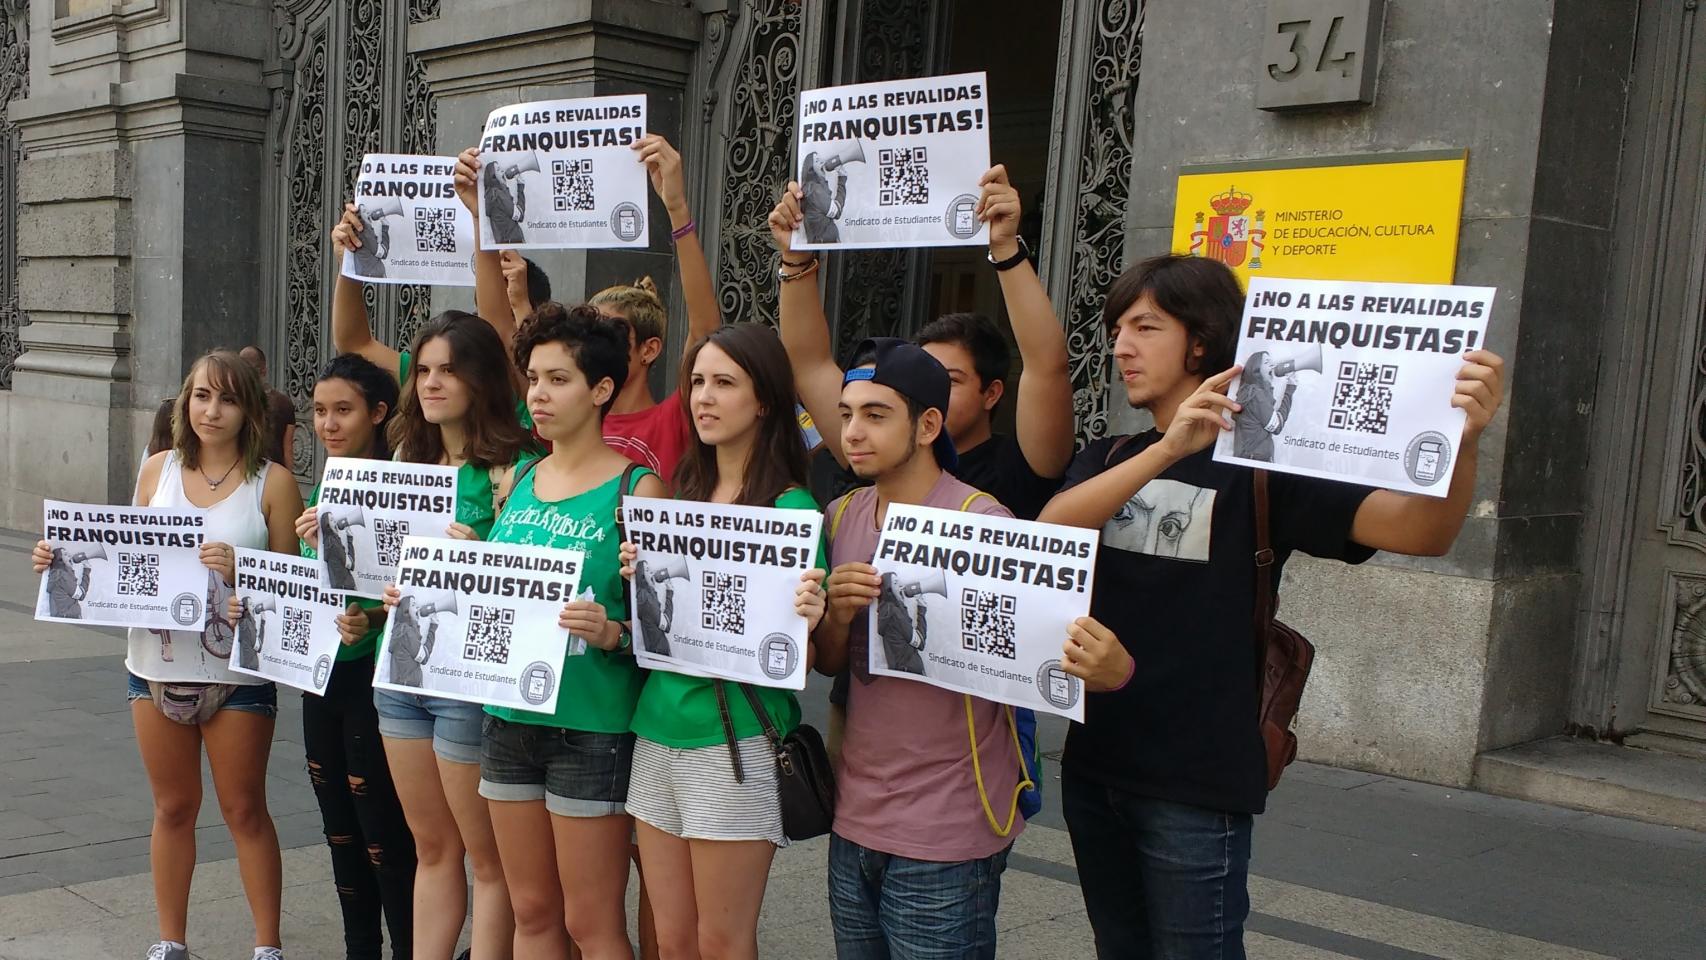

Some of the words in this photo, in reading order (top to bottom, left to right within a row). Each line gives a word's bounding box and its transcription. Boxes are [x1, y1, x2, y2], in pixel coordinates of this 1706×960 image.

[1268, 16, 1355, 82] 34
[804, 100, 827, 117] ¡NO
[832, 98, 842, 111] A
[848, 95, 878, 109] LAS
[884, 85, 981, 107] REVALIDAS
[488, 116, 506, 131] ¡NO
[510, 114, 519, 126] A
[525, 111, 550, 124] LAS
[556, 105, 641, 122] REVALIDAS
[803, 109, 983, 142] FRANQUISTAS!
[481, 127, 642, 152] FRANQUISTAS!
[376, 163, 385, 174] A
[391, 164, 418, 174] LAS
[357, 181, 455, 199] FRANQUIS
[569, 220, 607, 228] Estudiantes
[845, 217, 880, 226] Sindicato
[882, 217, 892, 225] de
[895, 215, 941, 224] Estudiantes
[1276, 210, 1343, 222] MINISTERIO
[1274, 228, 1290, 238] DE
[1292, 225, 1371, 238] EDUCACIÓN,
[1375, 224, 1434, 236] CULTURA
[1272, 246, 1280, 255] Y
[1282, 244, 1336, 255] DEPORTE
[1253, 291, 1291, 308] ¡NO
[1297, 293, 1311, 309] A
[1318, 294, 1354, 311] LAS
[1362, 296, 1484, 318] REVALIDAS
[1247, 316, 1478, 354] FRANQUISTAS!
[1284, 435, 1325, 450] Sindicato
[1328, 442, 1340, 452] de
[1343, 444, 1400, 460] Estudiantes
[326, 469, 343, 481] ¡NO
[346, 470, 352, 480] A
[357, 470, 377, 482] LAS
[382, 472, 452, 488] REVALIDAS
[321, 488, 452, 514] FRANQUISTAS!
[48, 510, 68, 520] ¡NO
[74, 512, 83, 521] A
[89, 512, 114, 523] LAS
[120, 514, 203, 526] REVALIDAS
[629, 508, 654, 523] ¡NO
[660, 510, 669, 524] A
[676, 512, 704, 527] LAS
[711, 515, 812, 538] REVALIDAS
[48, 526, 204, 548] FRANQUISTAS!
[630, 530, 810, 569] FRANQUISTAS!
[887, 516, 917, 532] ¡NO
[922, 520, 933, 534] A
[940, 522, 974, 540] LAS
[980, 528, 1090, 558] REVALIDAS
[239, 557, 256, 568] ¡NO
[260, 560, 266, 570] A
[270, 561, 288, 573] LAS
[405, 547, 428, 560] ¡NO
[433, 548, 443, 561] A
[449, 549, 477, 564] LAS
[483, 553, 576, 574] REVALIDAS
[880, 539, 1088, 593] FRANQUISTAS!
[239, 574, 344, 608] FRANQUISTAS!
[400, 568, 573, 602] FRANQUISTAS!
[88, 601, 117, 609] Sindicato
[130, 603, 168, 612] Estudiantes
[674, 634, 703, 647] Sindicato
[705, 640, 714, 649] de
[716, 642, 755, 657] Estudiantes
[430, 665, 461, 677] Sindicato
[464, 670, 473, 678] de
[475, 672, 516, 685] Estudiantes
[929, 653, 965, 668] Sindicato
[968, 663, 978, 672] de
[981, 665, 1032, 684] Estudiantes
